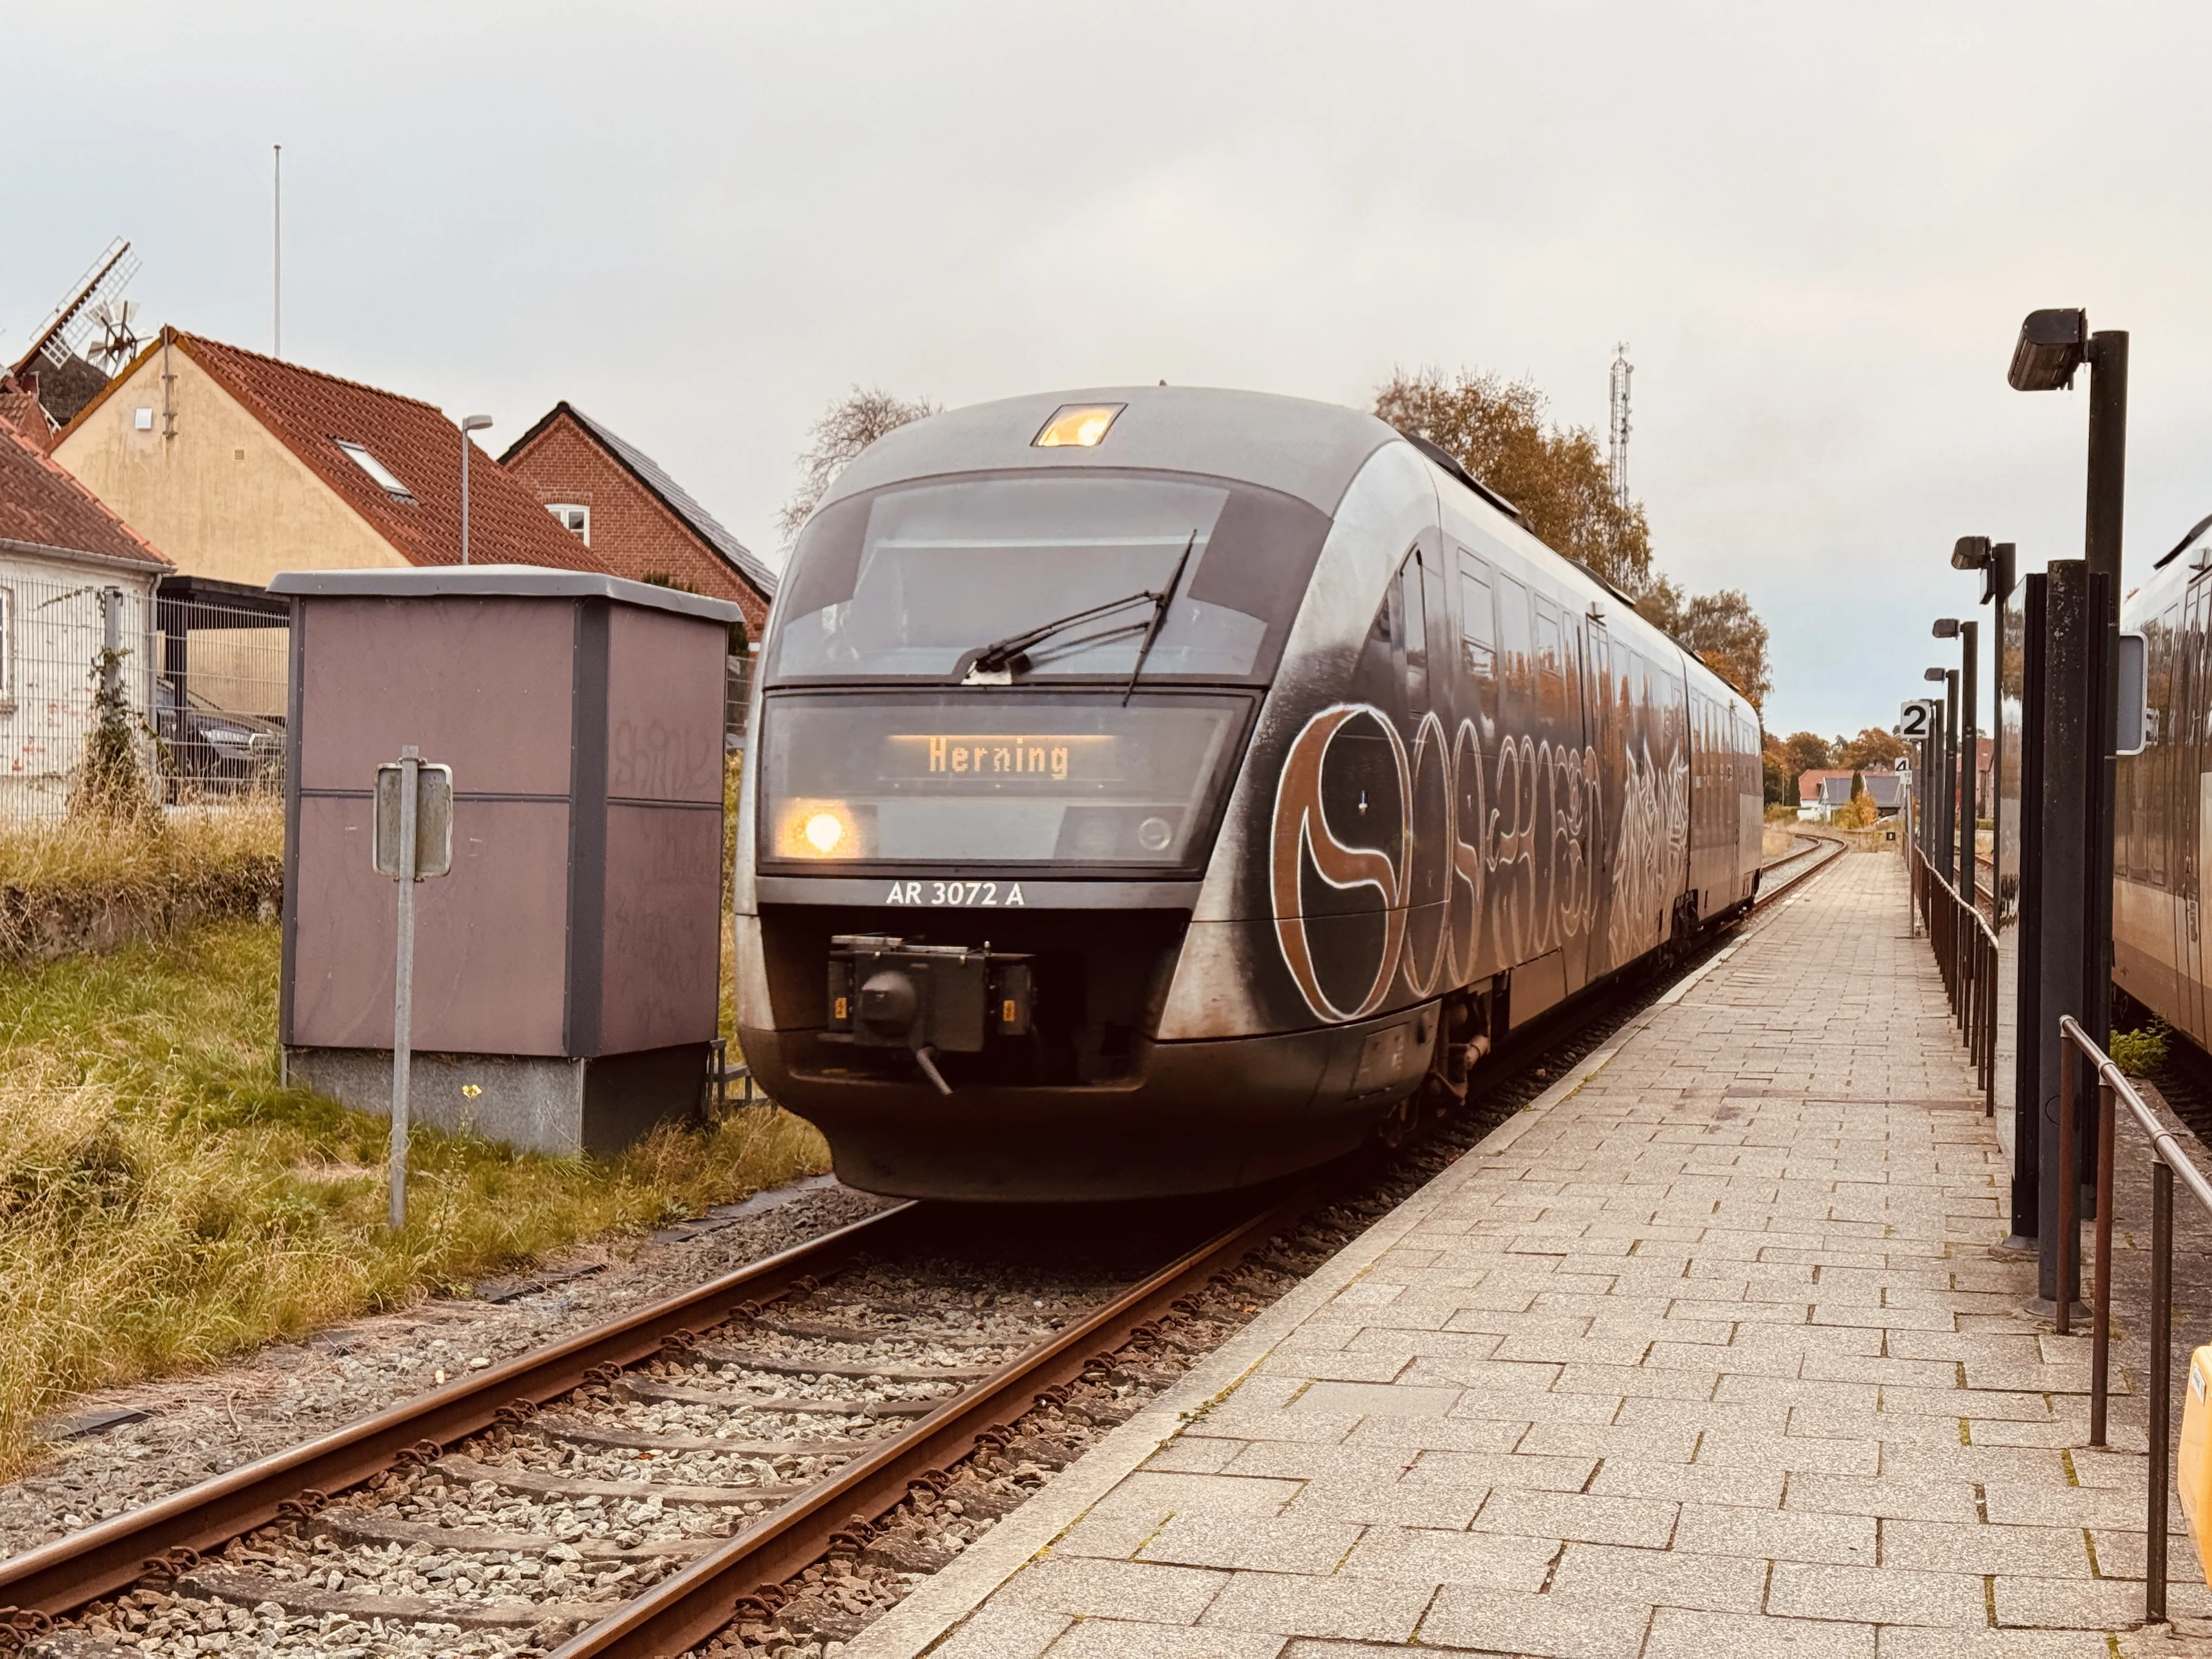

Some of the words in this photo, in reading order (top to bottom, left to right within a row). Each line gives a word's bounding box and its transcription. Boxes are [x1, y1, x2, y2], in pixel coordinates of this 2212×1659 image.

[1904, 706, 1926, 735] 2
[929, 737, 1068, 780] Herning
[1895, 760, 1907, 771] 4
[885, 882, 922, 904] AR
[931, 882, 997, 905] 3072
[1005, 883, 1024, 905] A
